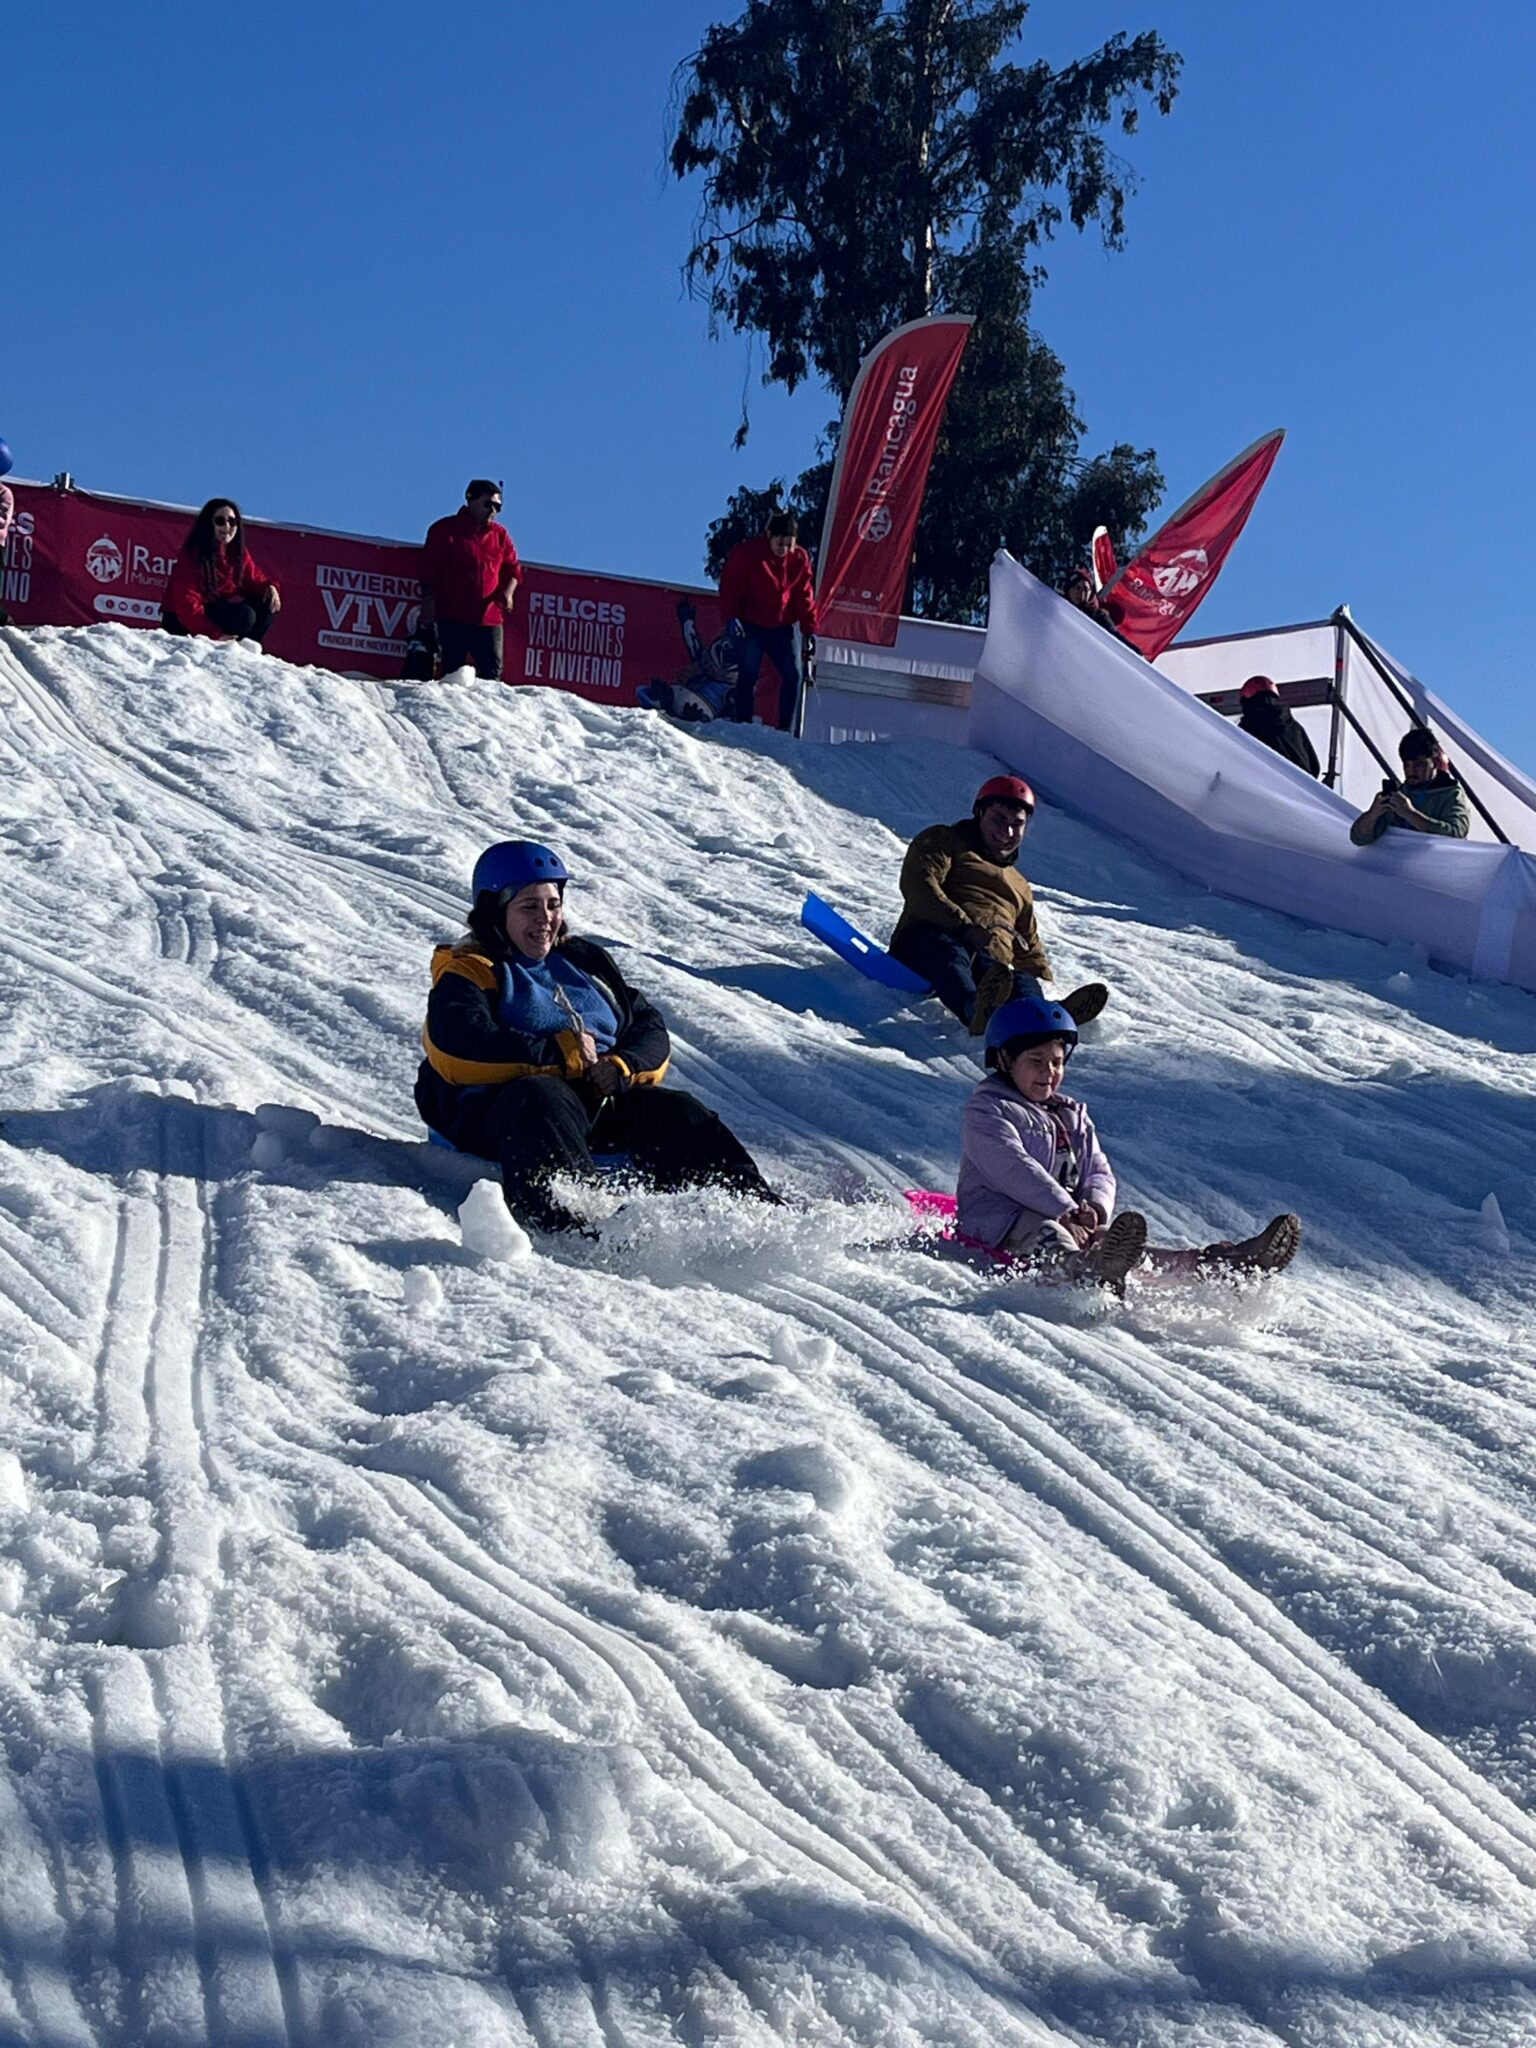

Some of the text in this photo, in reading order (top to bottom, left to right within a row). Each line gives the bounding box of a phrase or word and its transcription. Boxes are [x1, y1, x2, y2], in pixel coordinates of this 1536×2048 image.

[868, 366, 918, 496] Rancagua
[529, 592, 626, 625] FELICES
[528, 613, 625, 658] VACACIONES
[524, 647, 623, 688] DE INVIERNO
